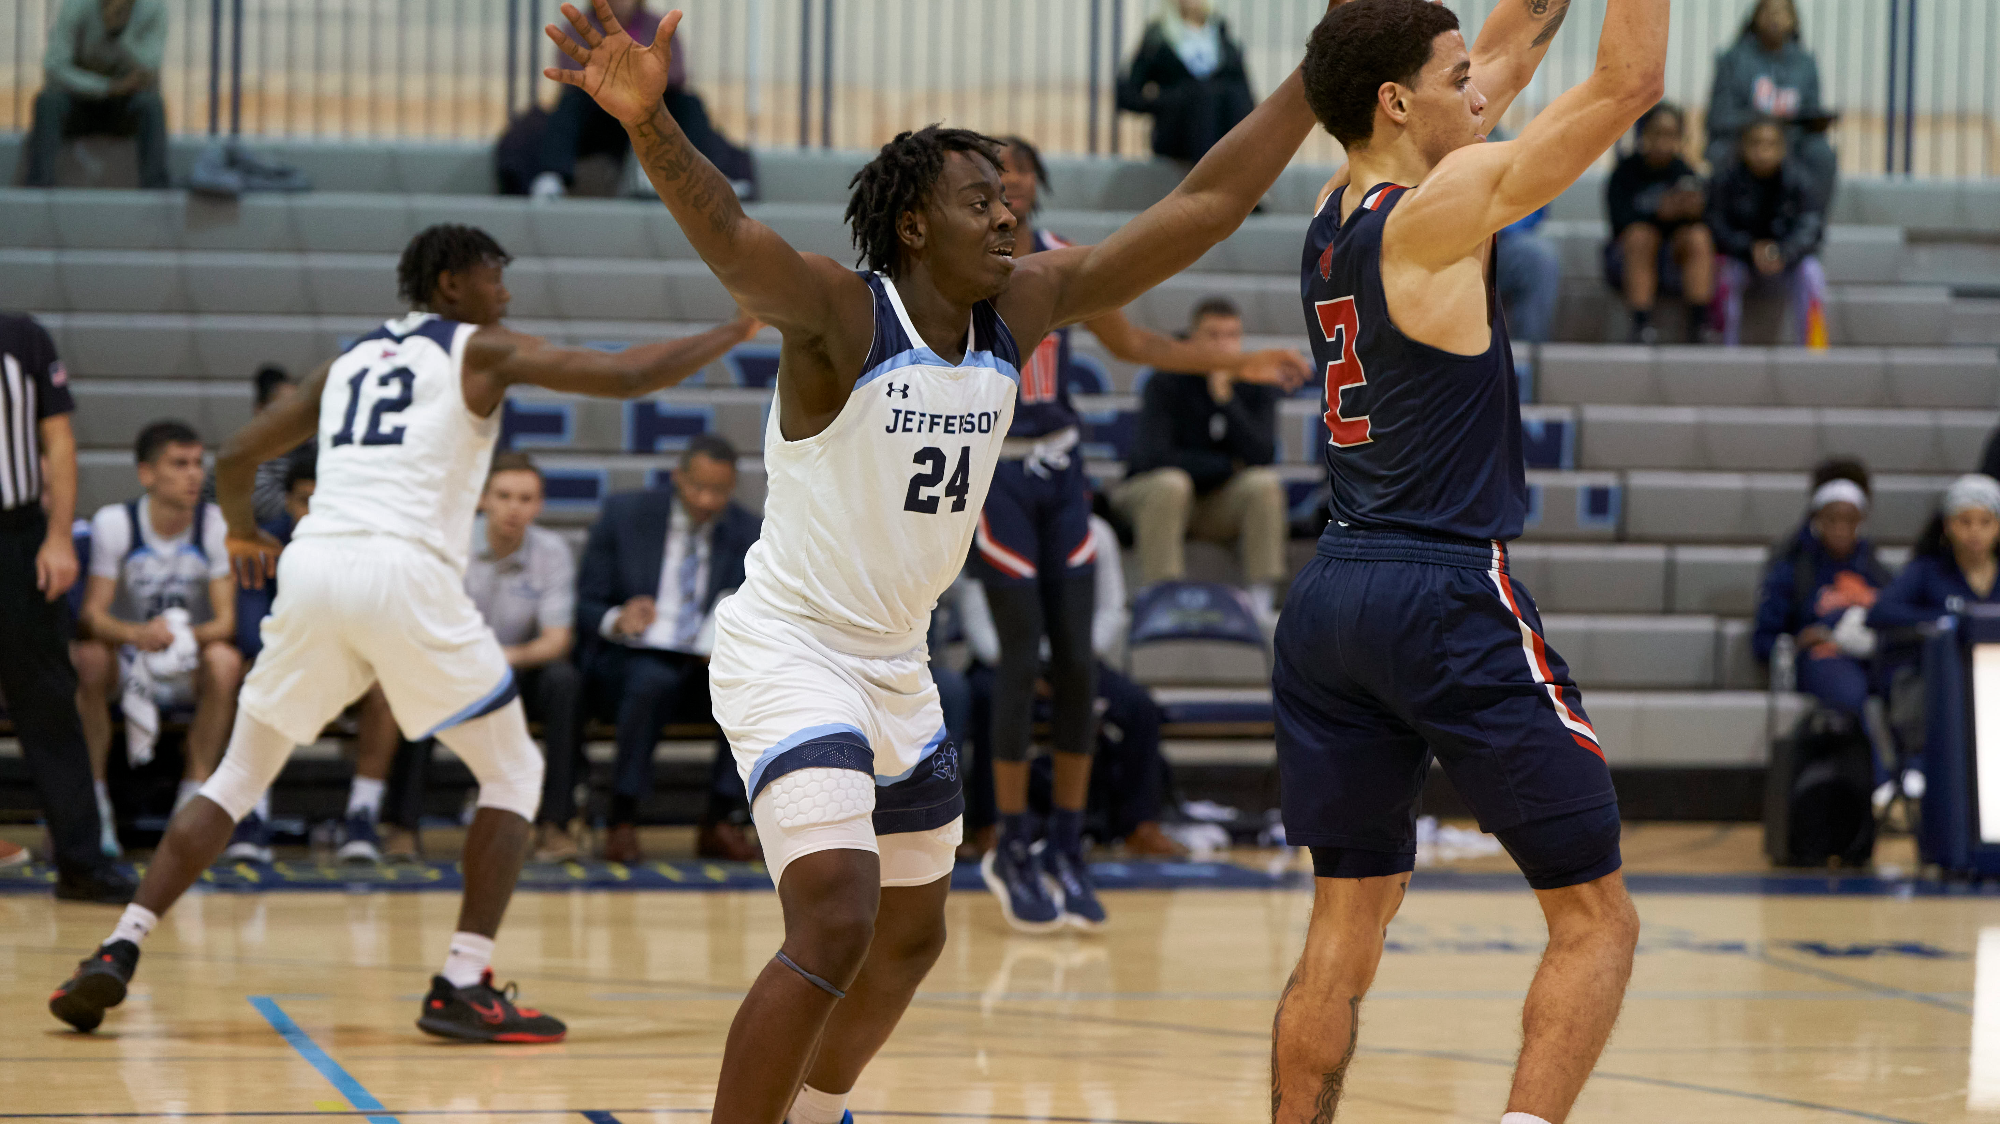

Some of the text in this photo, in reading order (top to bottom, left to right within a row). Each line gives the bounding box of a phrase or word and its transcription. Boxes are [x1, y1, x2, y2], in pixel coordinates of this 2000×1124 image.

[331, 366, 416, 448] 12
[1315, 295, 1374, 448] 2
[903, 445, 970, 514] 24
